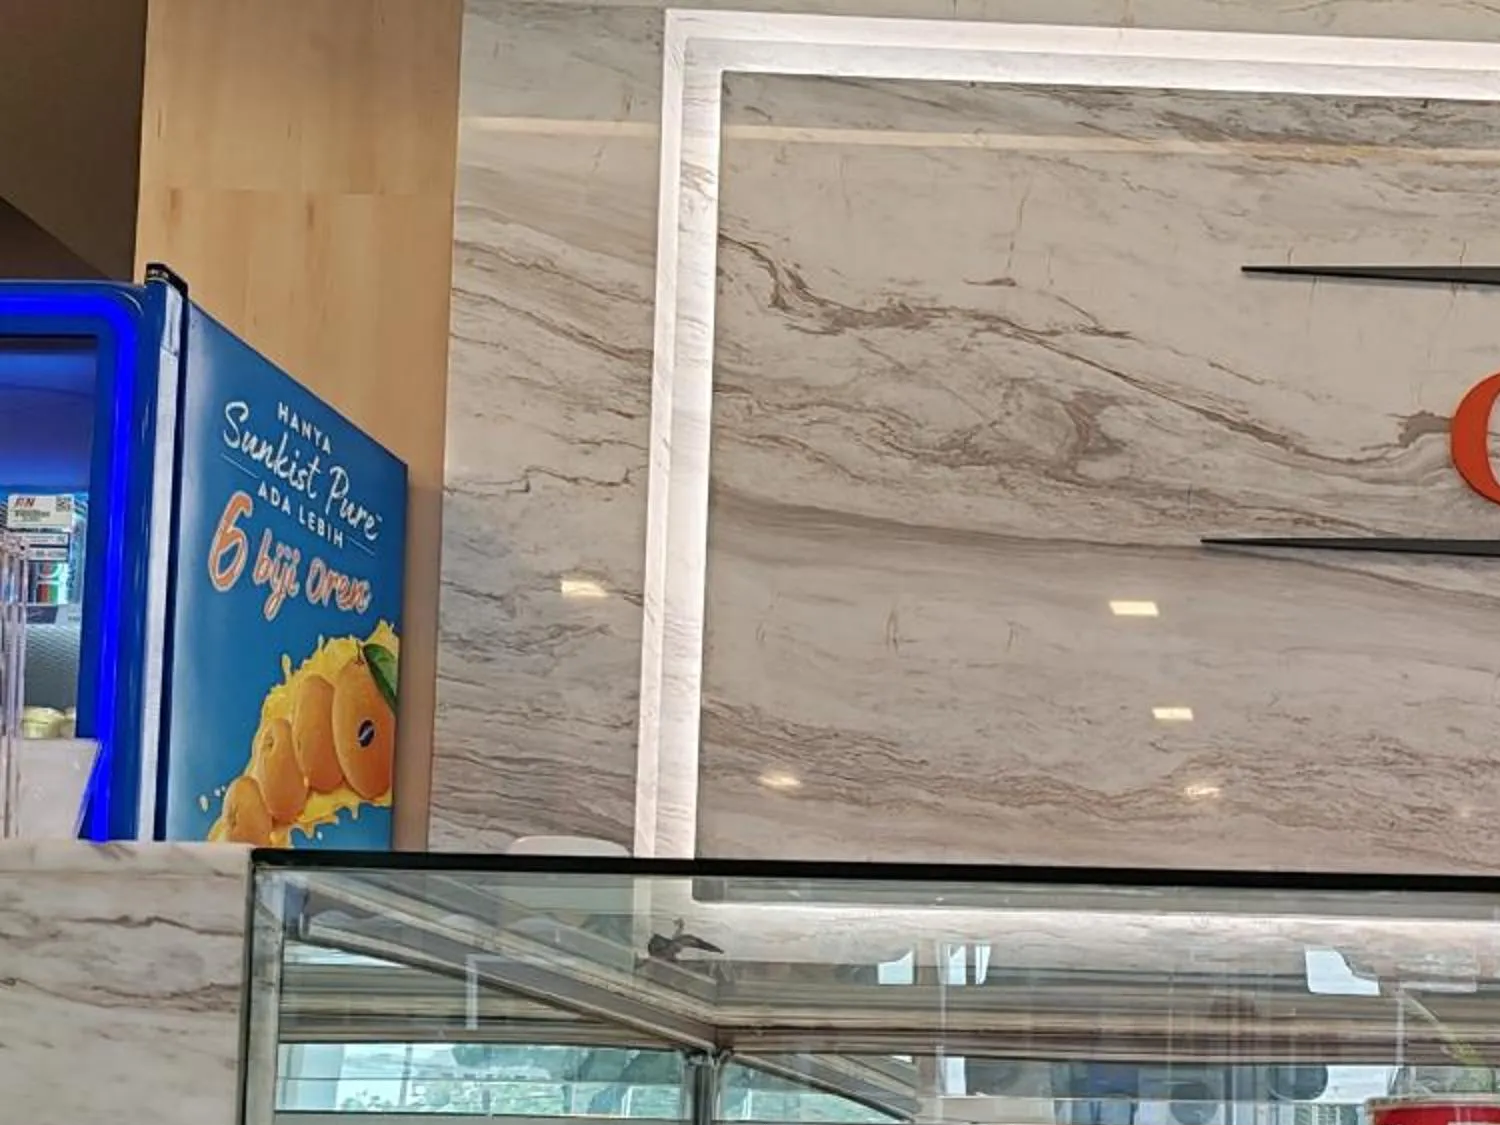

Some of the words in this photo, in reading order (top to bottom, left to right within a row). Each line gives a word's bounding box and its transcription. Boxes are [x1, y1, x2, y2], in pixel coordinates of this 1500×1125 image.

[223, 401, 321, 498] Sunkist
[325, 464, 383, 541] Pure
[277, 401, 331, 454] HANYA
[208, 490, 254, 592] 6
[253, 527, 301, 622] biji
[305, 556, 372, 614] Oren
[257, 480, 291, 516] ADA
[299, 504, 344, 549] LEBIH
